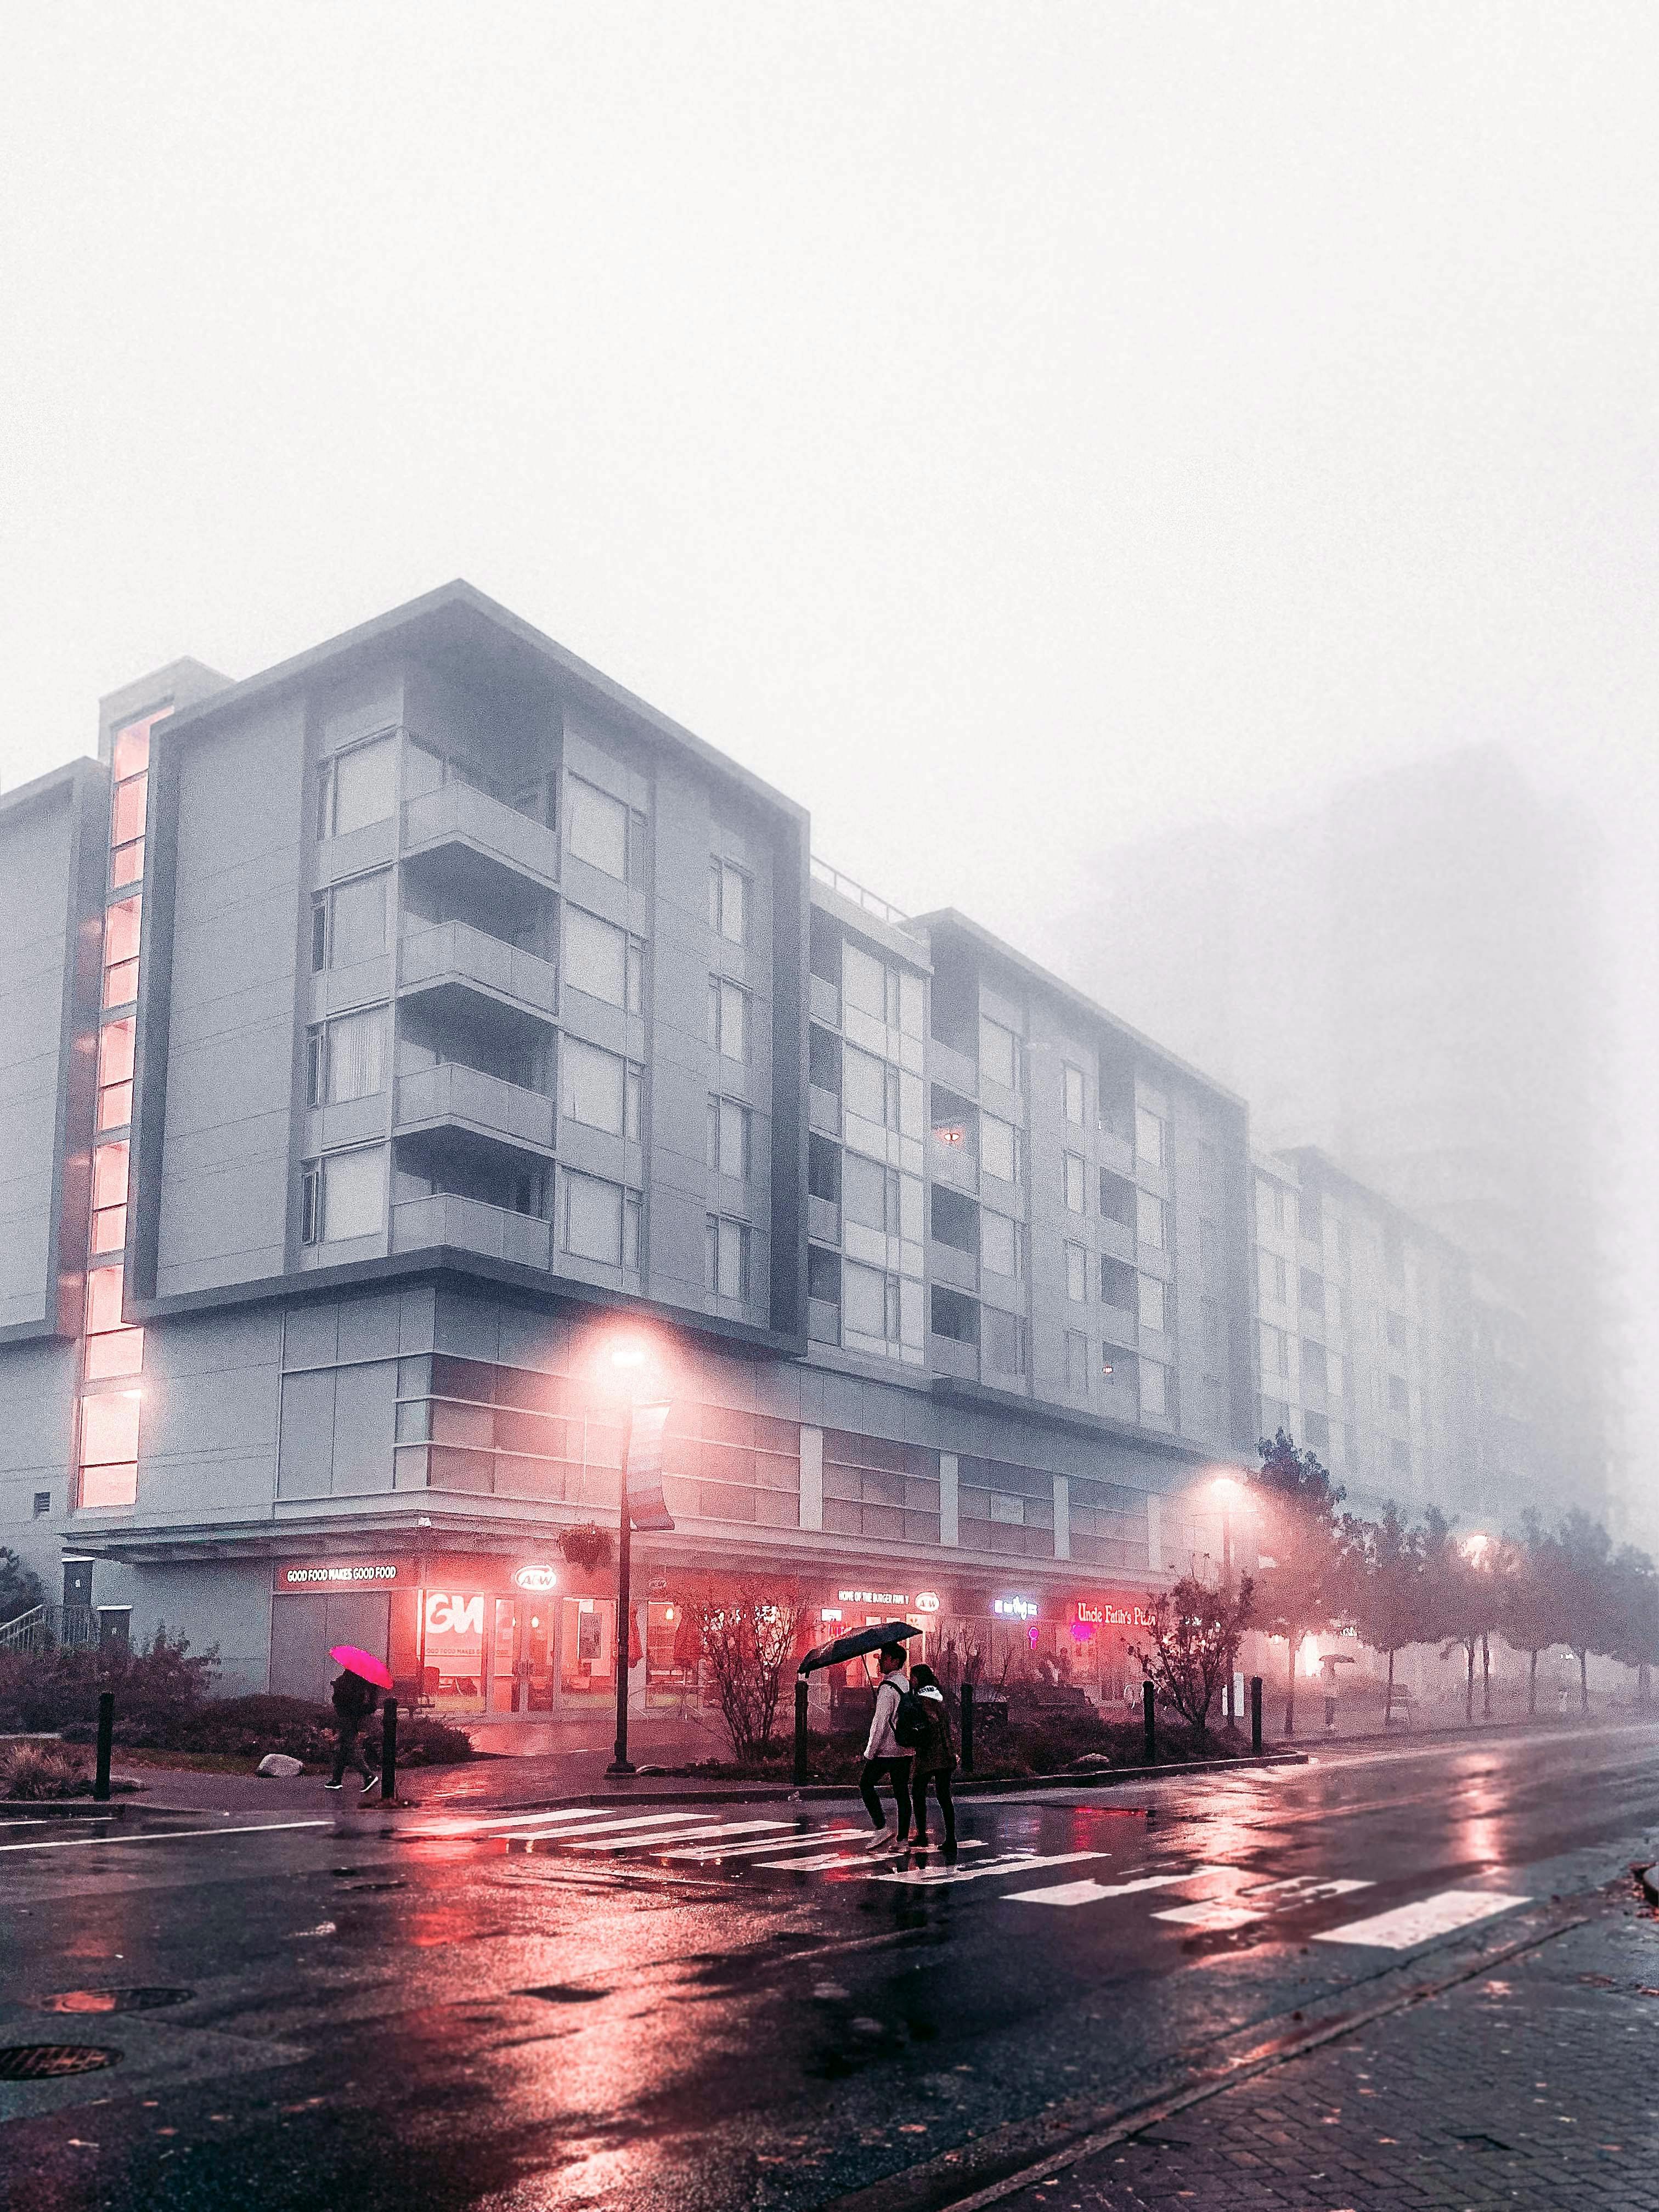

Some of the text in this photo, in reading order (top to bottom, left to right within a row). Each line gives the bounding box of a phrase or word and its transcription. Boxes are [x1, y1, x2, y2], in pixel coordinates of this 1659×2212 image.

[287, 1565, 397, 1582] GOOD FOOD MAKES GOOD FOOD
[838, 1590, 854, 1601] HOME
[854, 1592, 863, 1602] OF
[862, 1592, 872, 1604] THE
[872, 1593, 892, 1605] BURGER
[1077, 1602, 1103, 1623] Uncle
[1105, 1604, 1132, 1625] Fatih's
